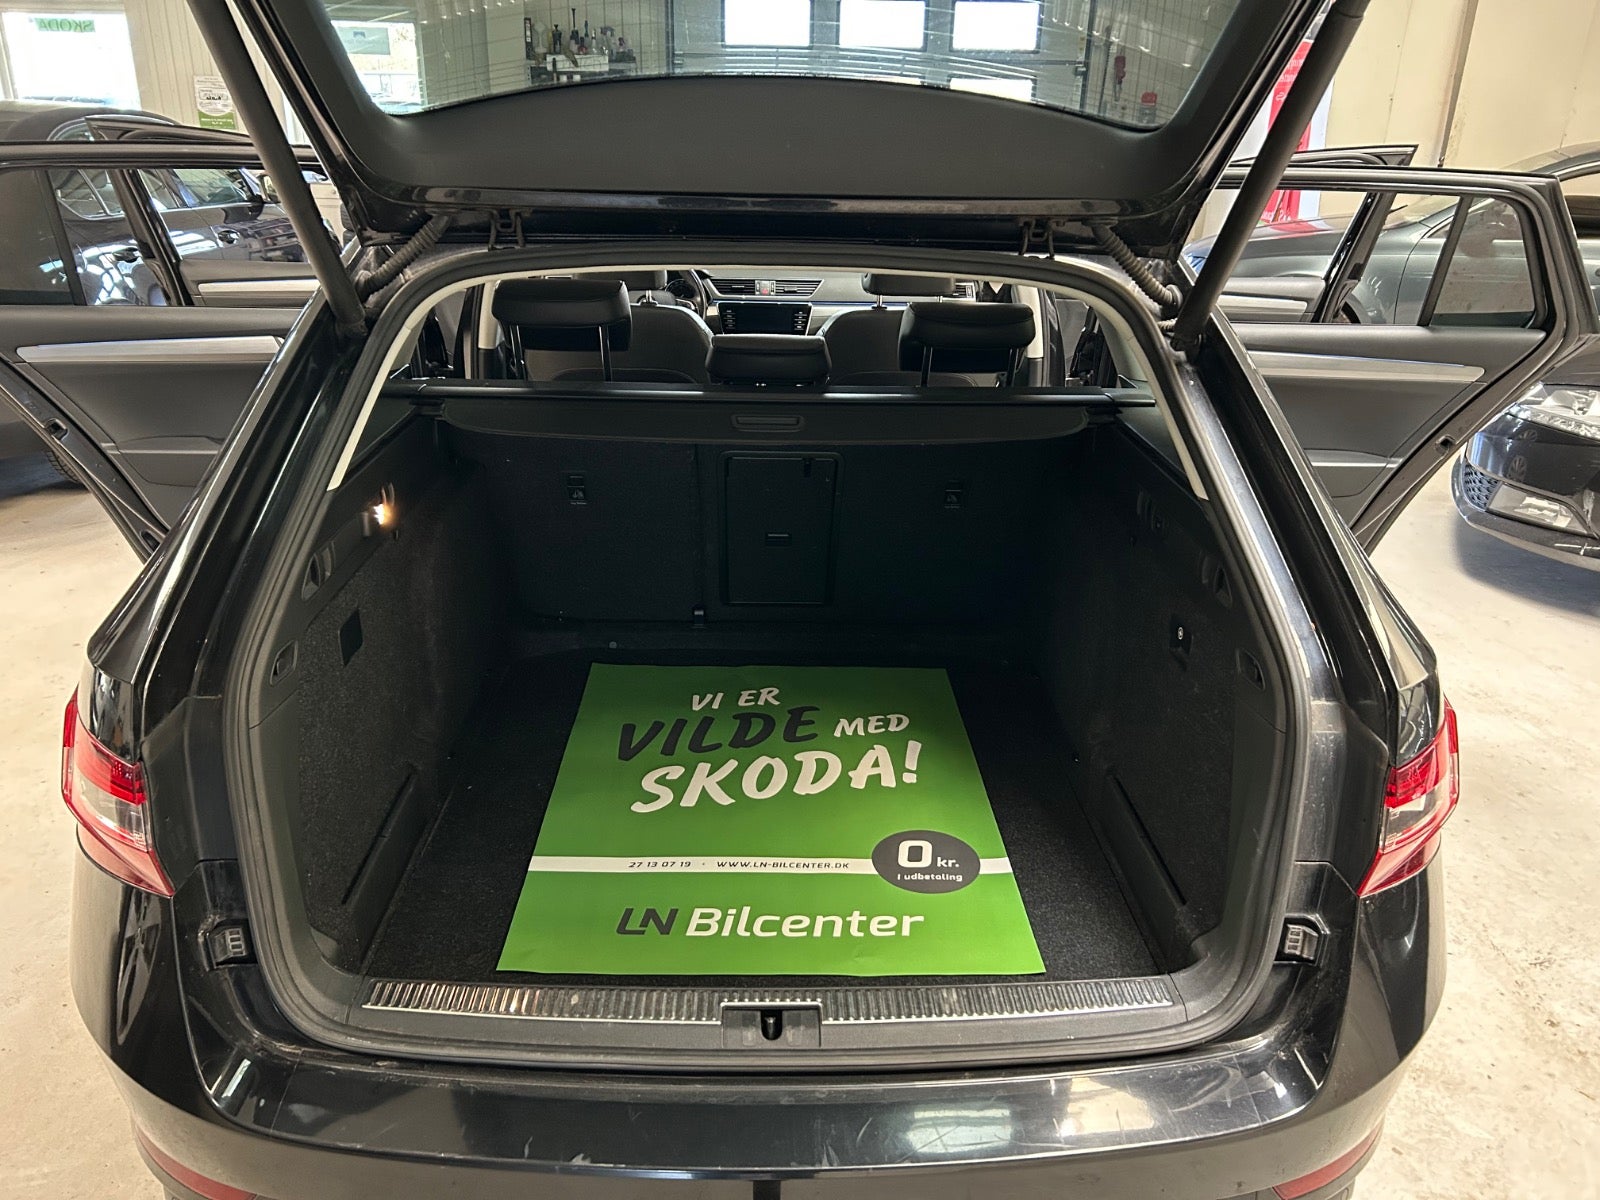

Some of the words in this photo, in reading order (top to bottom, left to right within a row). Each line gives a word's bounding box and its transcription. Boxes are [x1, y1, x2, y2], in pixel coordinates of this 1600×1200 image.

[691, 691, 724, 711] VI
[737, 687, 781, 707] ER
[617, 705, 820, 762] VILDE
[833, 713, 910, 737] MED
[630, 740, 922, 813] SKODA!
[716, 861, 849, 869] WWW.LN-BILCENTER.DK
[897, 839, 933, 868] 0
[936, 856, 960, 868] kr.
[903, 872, 963, 882] udbetaling
[615, 907, 679, 935] LN
[685, 906, 924, 937] Bilcenter
